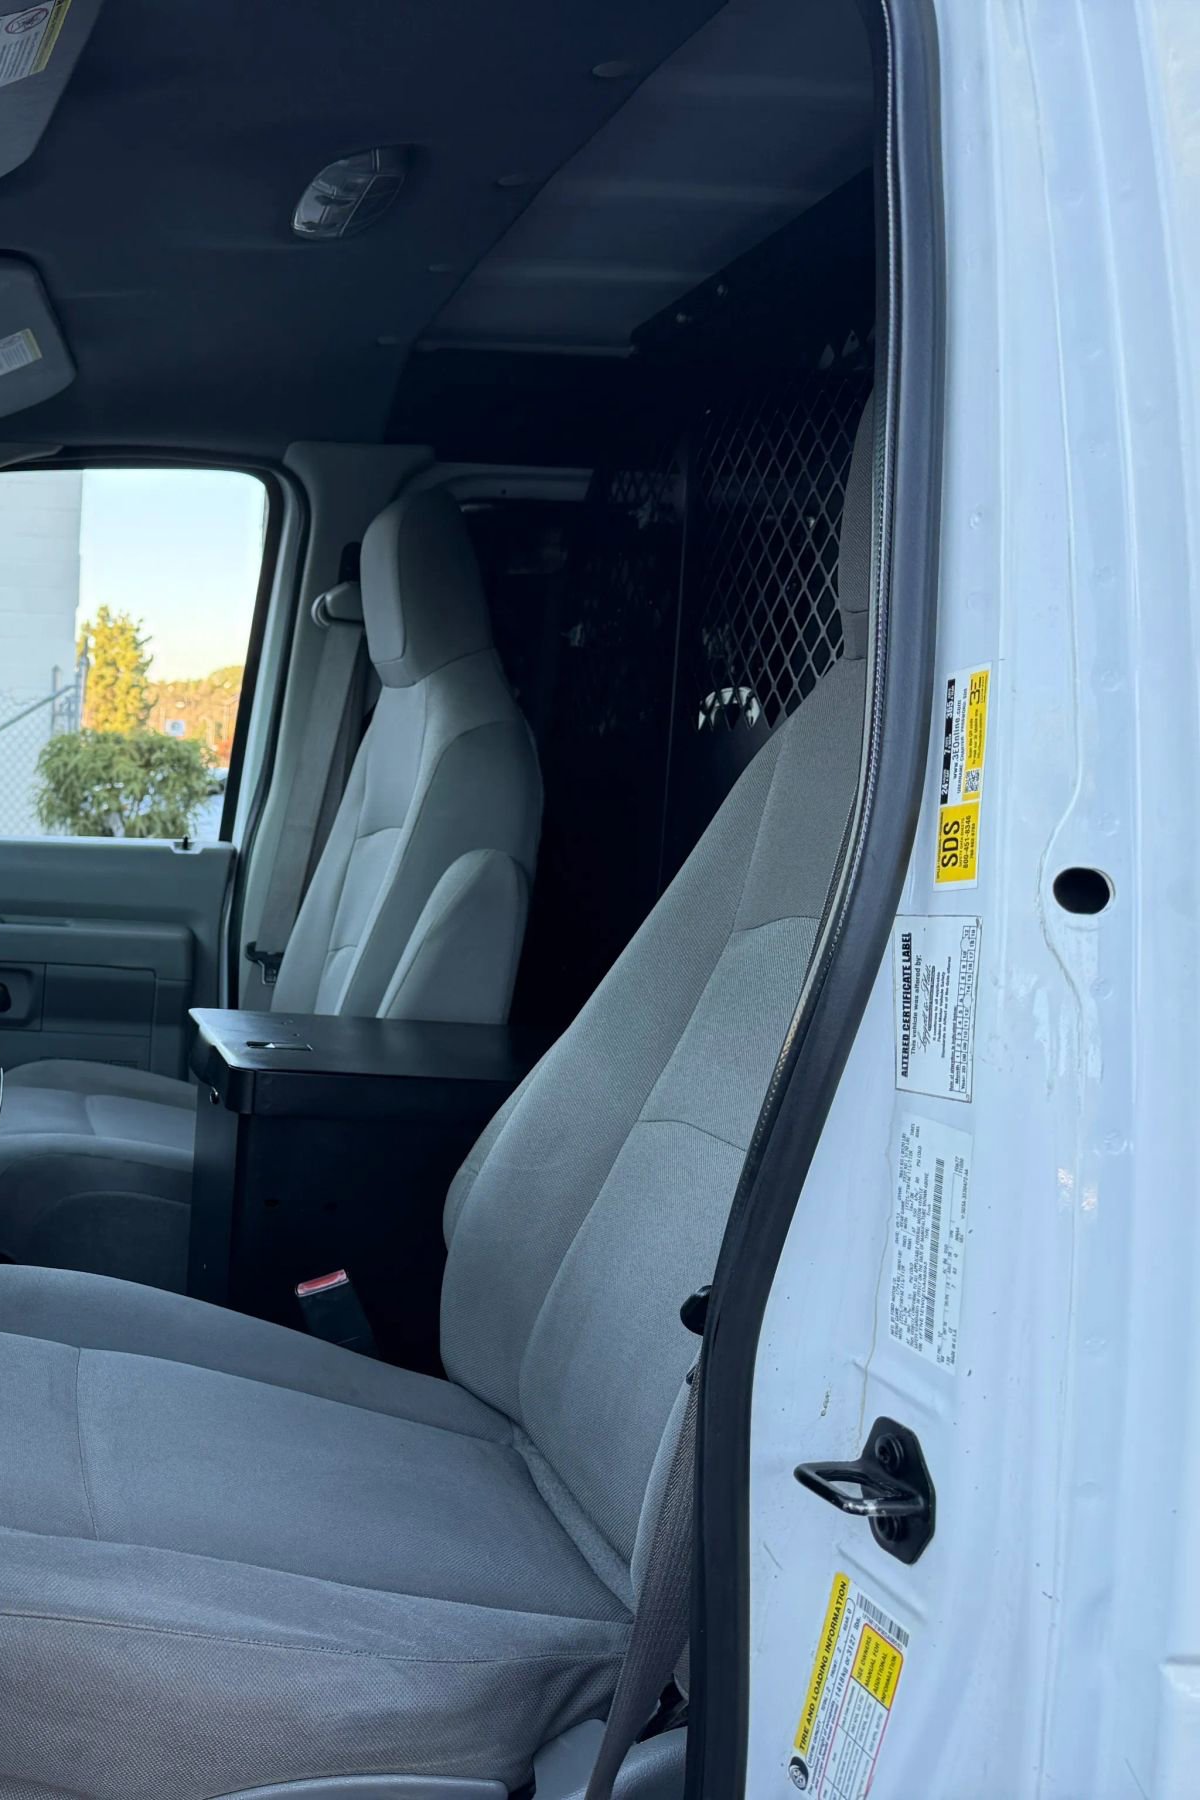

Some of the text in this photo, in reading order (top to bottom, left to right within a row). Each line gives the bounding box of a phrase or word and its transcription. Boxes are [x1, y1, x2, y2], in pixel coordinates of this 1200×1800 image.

[941, 783, 948, 795] 24
[941, 820, 960, 868] SDS
[963, 816, 971, 868] 800-451-8346
[901, 932, 911, 1077] ALTERED CERTIFICATE LABEL
[845, 1657, 850, 1665] or
[846, 1634, 856, 1656] 3127
[860, 1636, 872, 1665] OWNERS
[800, 1581, 846, 1751] TIRE AND LOADING INFORMATION
[865, 1659, 876, 1687] MANUAL
[873, 1653, 887, 1694] ADDITIONAL
[881, 1656, 896, 1703] INFORMATION
